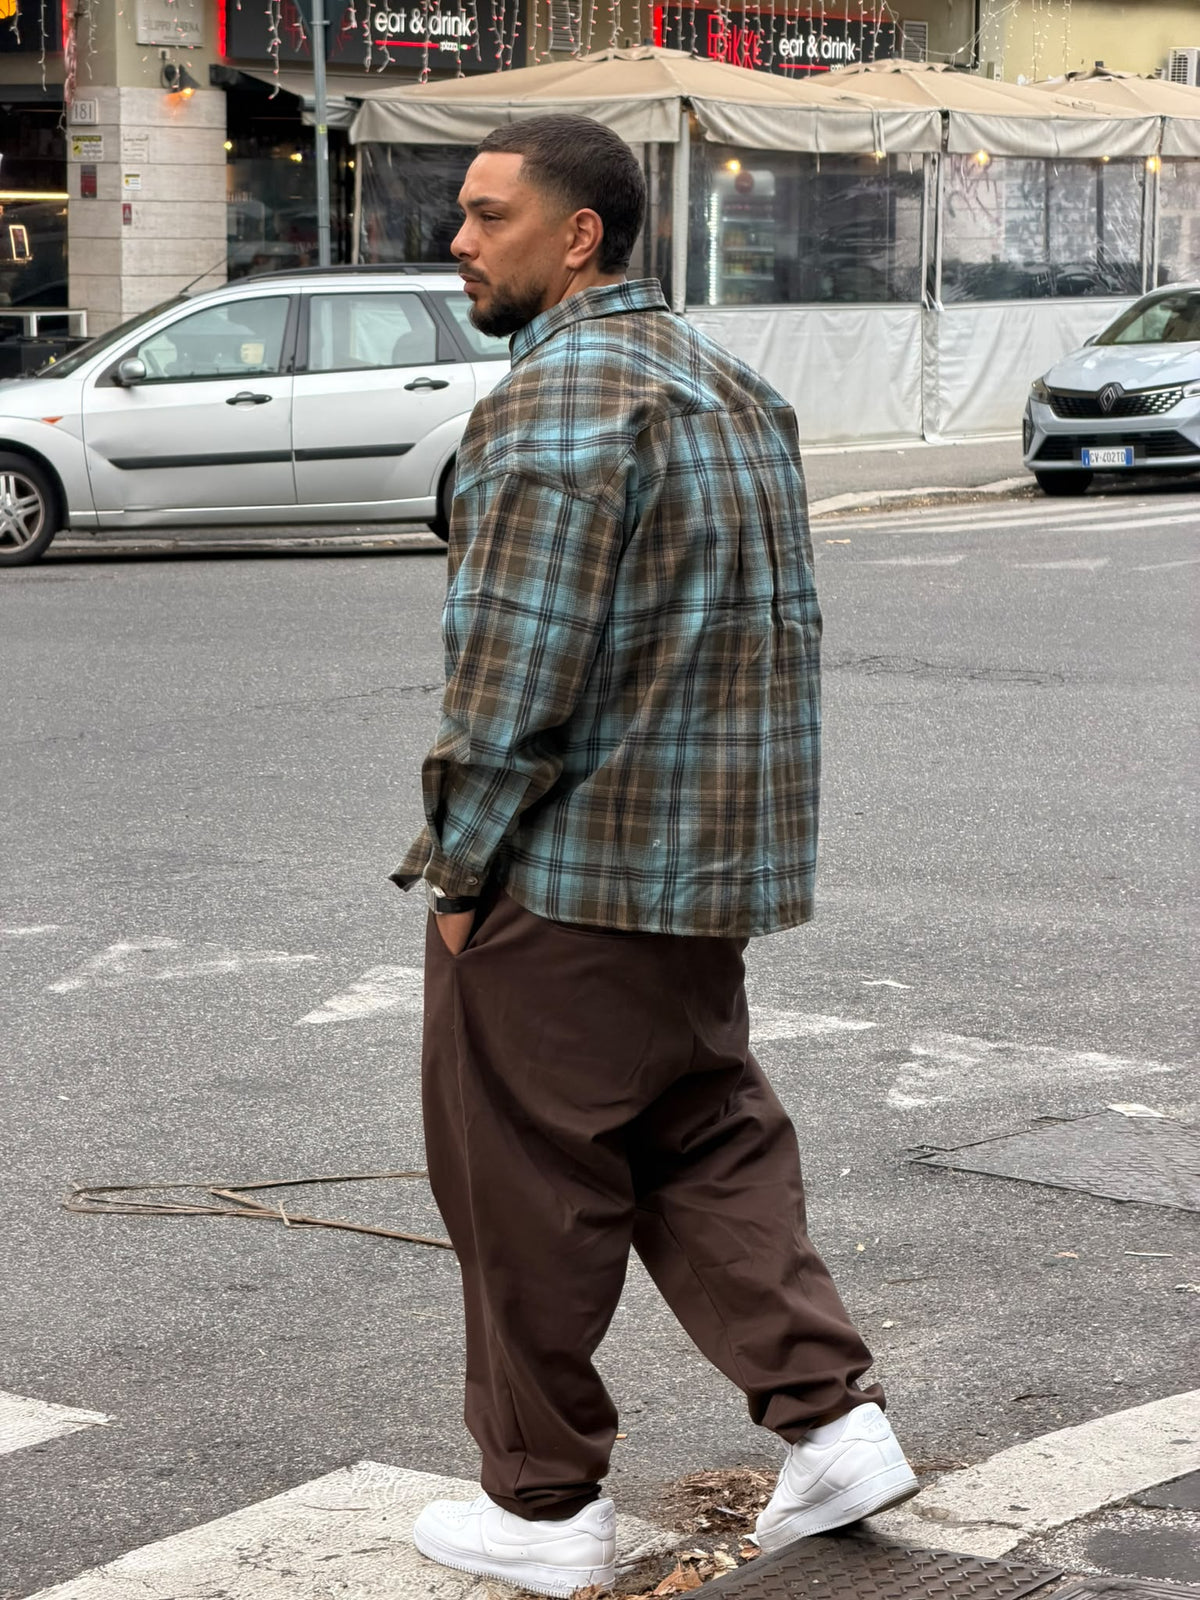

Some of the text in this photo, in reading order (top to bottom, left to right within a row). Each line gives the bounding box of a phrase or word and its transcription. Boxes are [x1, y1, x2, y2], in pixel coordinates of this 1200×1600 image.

[374, 8, 407, 33] eat
[409, 9, 425, 34] &
[428, 11, 472, 36] drink
[778, 35, 804, 58] eat
[807, 35, 820, 58] &
[821, 36, 856, 62] drink
[74, 103, 93, 120] 181
